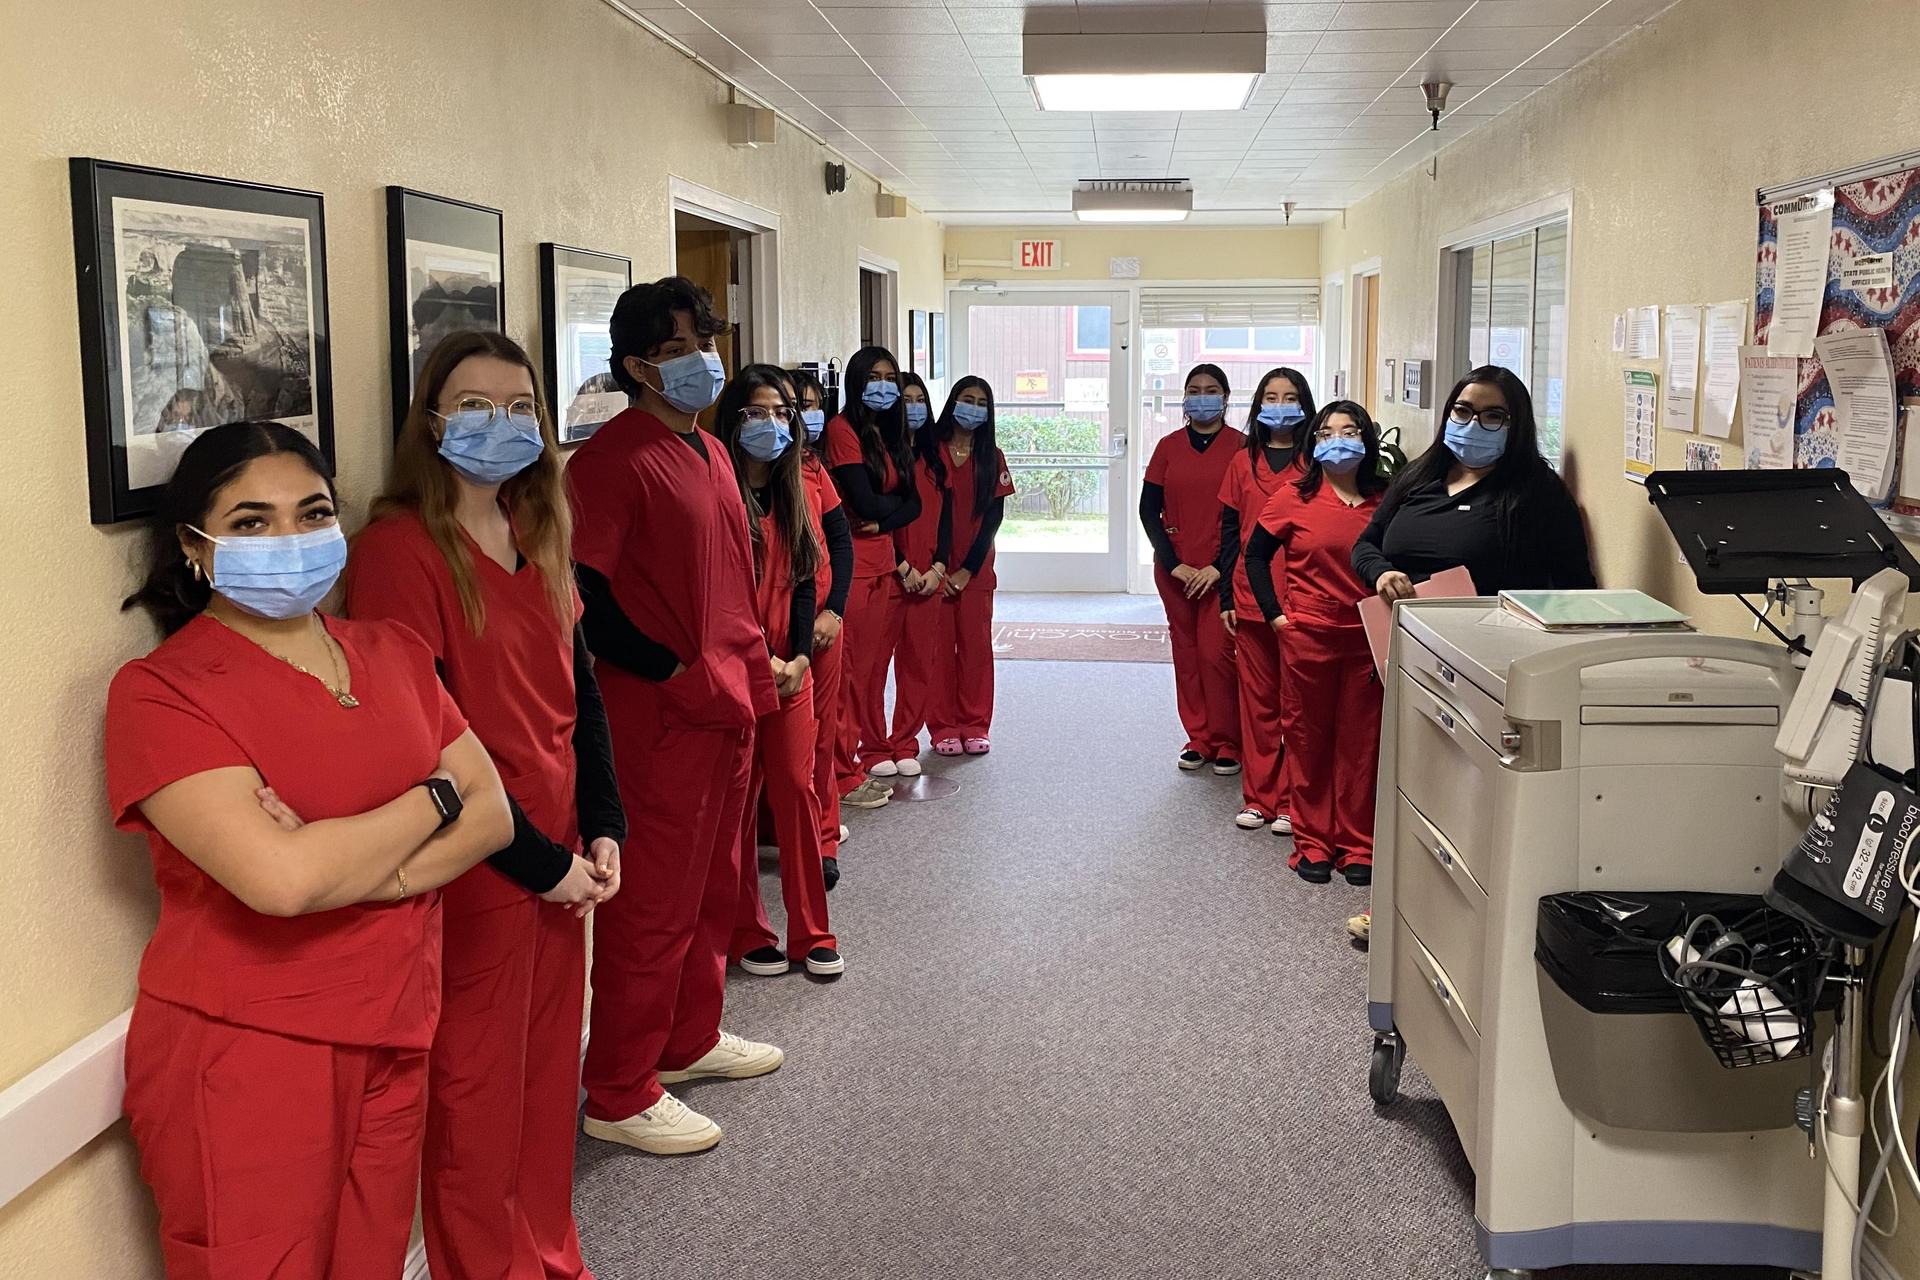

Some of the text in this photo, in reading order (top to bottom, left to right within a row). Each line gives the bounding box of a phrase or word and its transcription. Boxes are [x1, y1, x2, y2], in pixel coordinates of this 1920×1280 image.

[1022, 242, 1054, 267] EXIT
[1007, 631, 1166, 643] howchi
[1870, 818, 1883, 826] L
[1872, 804, 1920, 914] blood pressure cuff
[1849, 881, 1857, 892] cm
